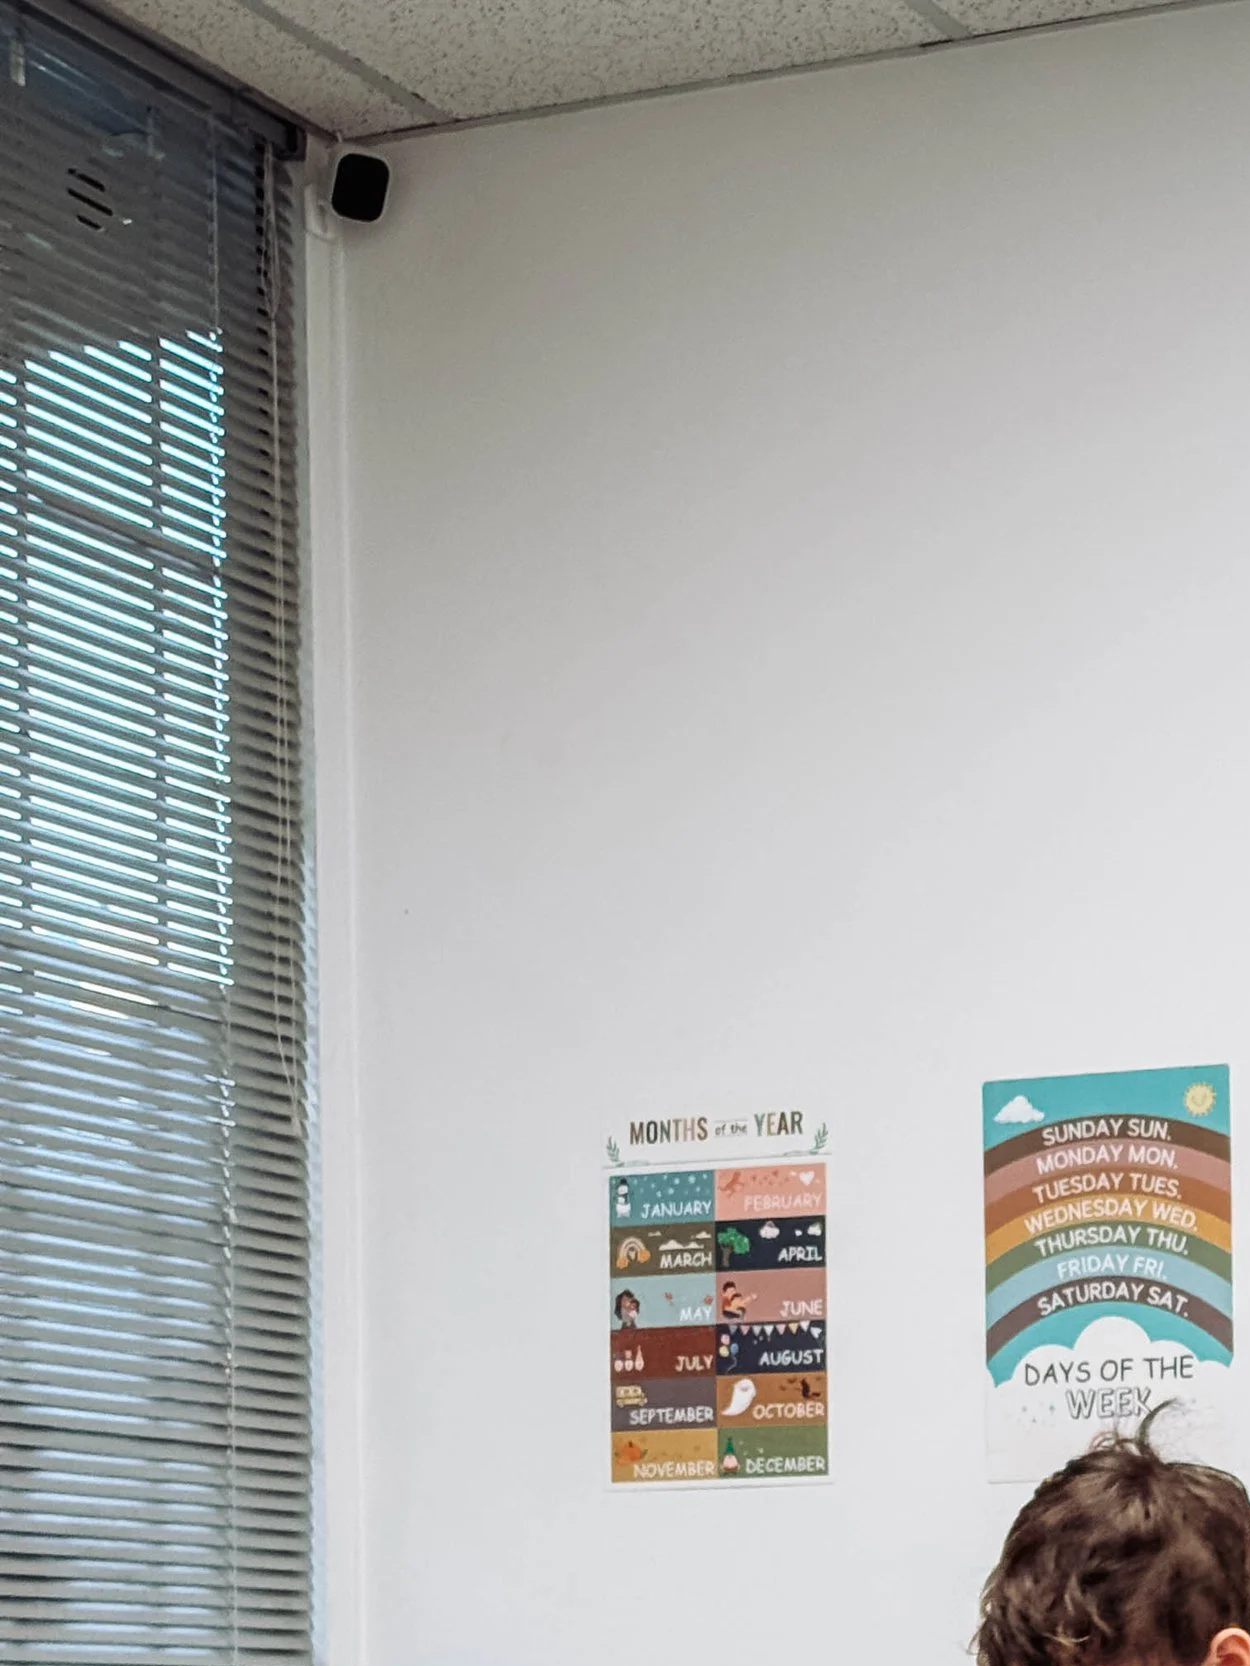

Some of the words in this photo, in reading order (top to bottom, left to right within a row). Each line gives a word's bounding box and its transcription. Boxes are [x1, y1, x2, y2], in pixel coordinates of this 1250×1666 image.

[630, 1117, 708, 1145] MONTHS
[714, 1123, 727, 1136] of
[730, 1121, 748, 1135] the
[754, 1111, 804, 1137] YEAR
[1042, 1119, 1124, 1146] SUNDAY
[1128, 1119, 1171, 1141] SUN.
[1036, 1145, 1122, 1175] MONDAY
[1129, 1147, 1178, 1169] MON.
[1033, 1172, 1124, 1203] TUESDAY
[1130, 1173, 1181, 1200] TUES.
[641, 1201, 712, 1219] JANUARY
[743, 1193, 822, 1211] FEBRUARY
[1024, 1200, 1146, 1234] WEDNESDAY
[1151, 1203, 1198, 1232] WED.
[1034, 1227, 1140, 1257] THURSDAY
[1147, 1228, 1189, 1255] THU.
[660, 1252, 712, 1268] MARCH
[777, 1246, 822, 1262] APRIL
[1057, 1254, 1129, 1280] FRIDAY
[1133, 1257, 1167, 1281] FRI.
[779, 1301, 822, 1317] JUNE
[1038, 1283, 1144, 1317] SATURDAY
[1147, 1287, 1189, 1317] SAT.
[679, 1307, 712, 1322] MAY
[675, 1355, 713, 1372] JULY
[758, 1350, 823, 1367] AUGUST
[1025, 1361, 1090, 1386] DAYS
[1100, 1358, 1134, 1381] OF
[1142, 1354, 1194, 1380] THE
[753, 1403, 824, 1420] OCTOBER
[1065, 1386, 1152, 1420] WEEK
[629, 1407, 714, 1425] SEPTEMBER
[633, 1463, 715, 1480] NOVEMBER
[745, 1456, 825, 1474] DECEMBER
